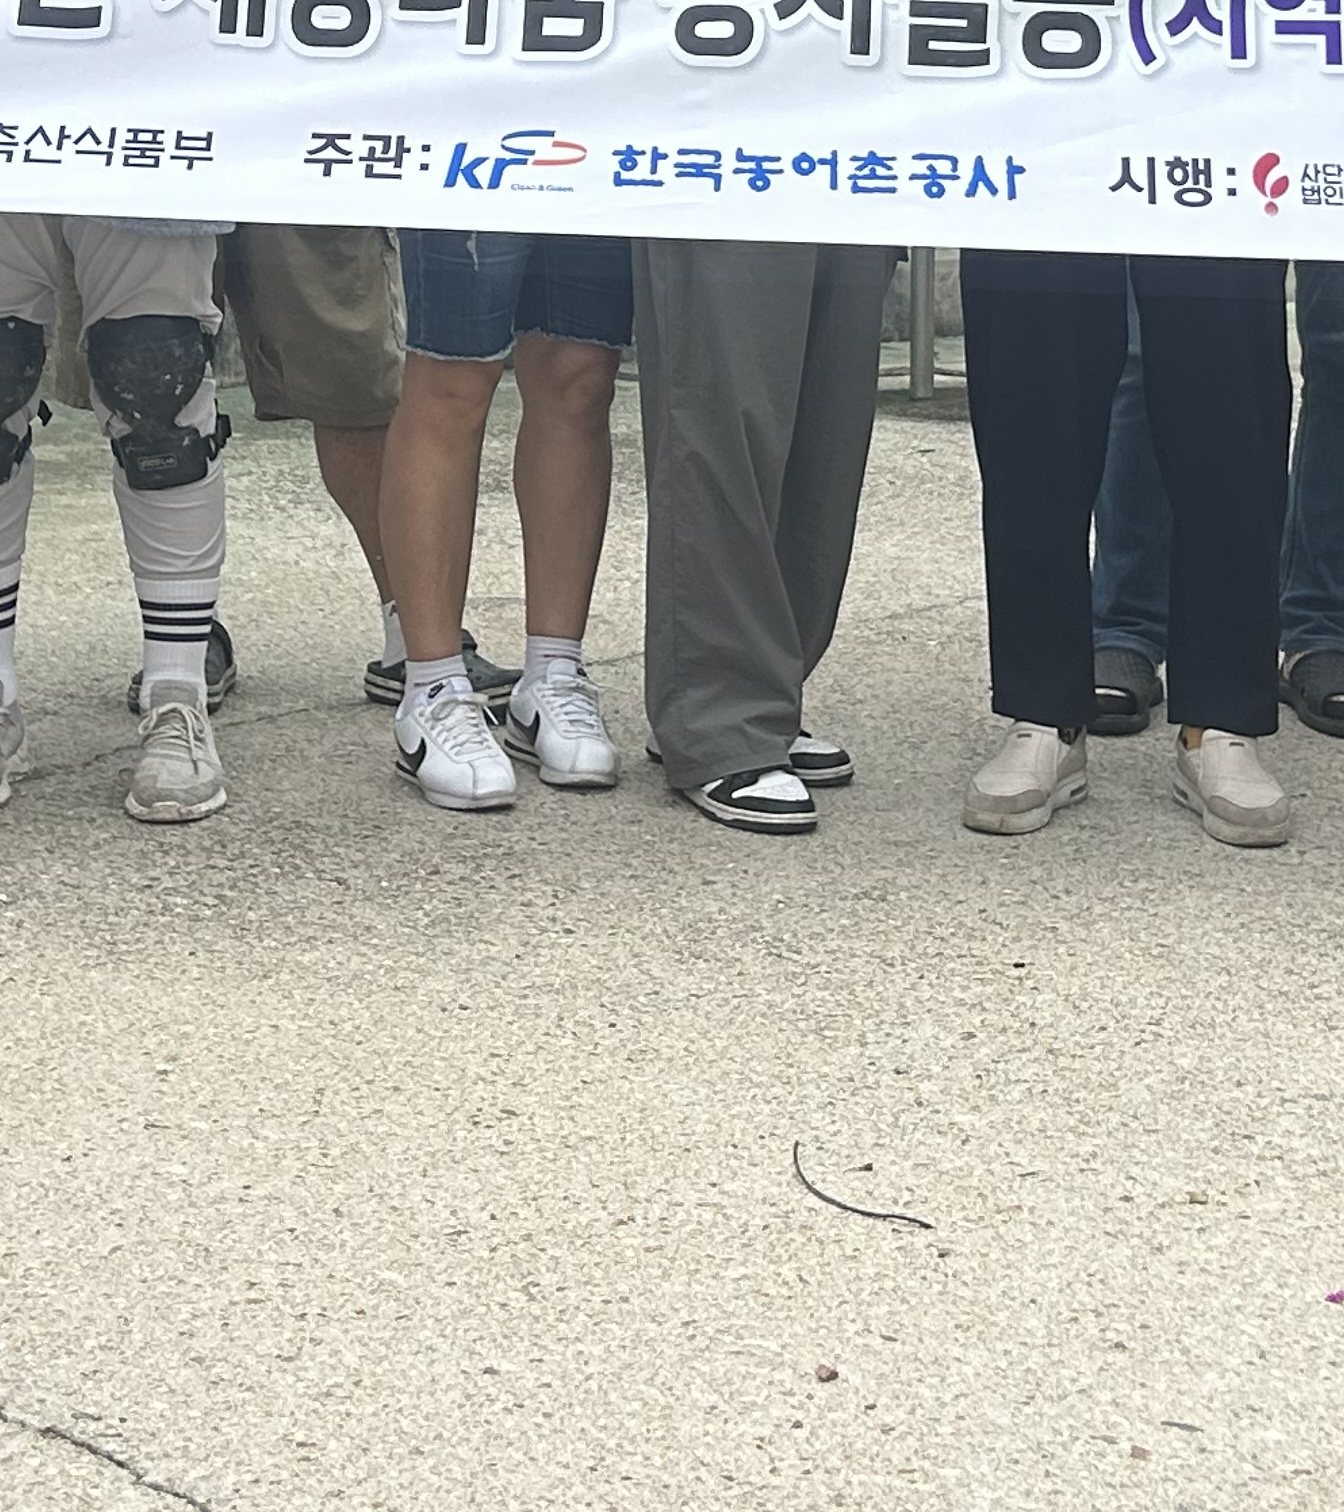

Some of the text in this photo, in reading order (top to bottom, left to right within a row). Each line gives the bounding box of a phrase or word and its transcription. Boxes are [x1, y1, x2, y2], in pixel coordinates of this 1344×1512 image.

[303, 132, 432, 179] 주관:
[611, 144, 1025, 201] 한국농어촌공사
[1301, 163, 1344, 184] 사단
[1109, 156, 1236, 207] 시행:
[1301, 185, 1344, 206] 법인
